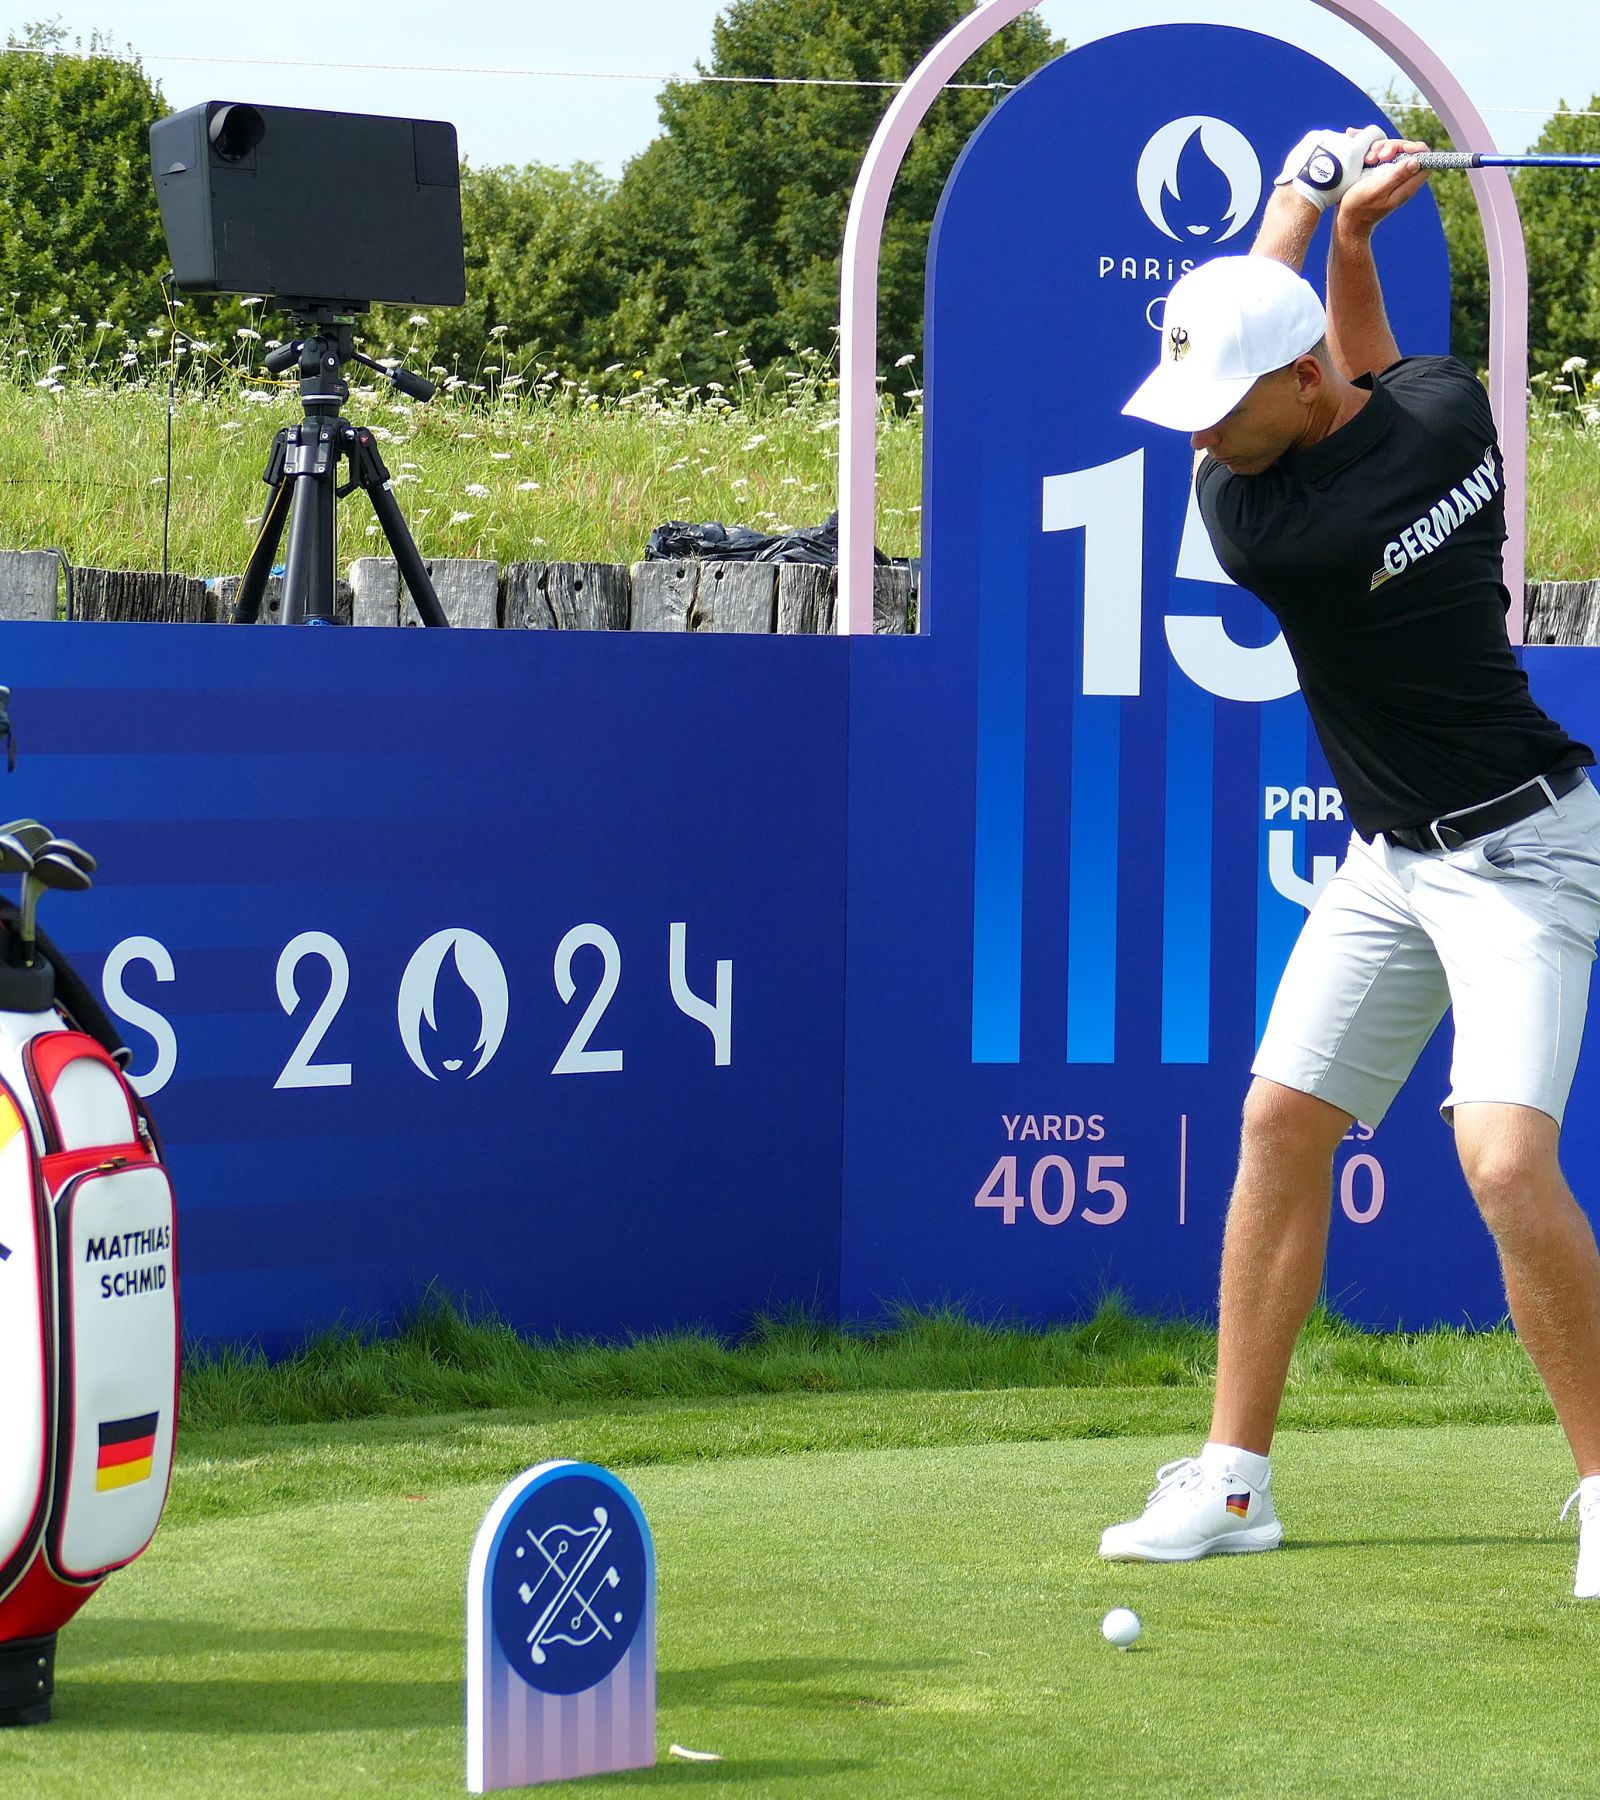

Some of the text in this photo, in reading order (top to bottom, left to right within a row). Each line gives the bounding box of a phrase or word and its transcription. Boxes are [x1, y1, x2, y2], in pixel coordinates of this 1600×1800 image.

[1384, 445, 1499, 577] GERMANY
[1041, 446, 1303, 703] 15
[1264, 786, 1345, 821] PAR
[272, 921, 733, 1089] 2024
[1001, 1114, 1106, 1142] YARDS
[974, 1154, 1128, 1226] 405
[86, 1225, 170, 1263] MATTHIAS
[101, 1264, 167, 1299] SCHMID
